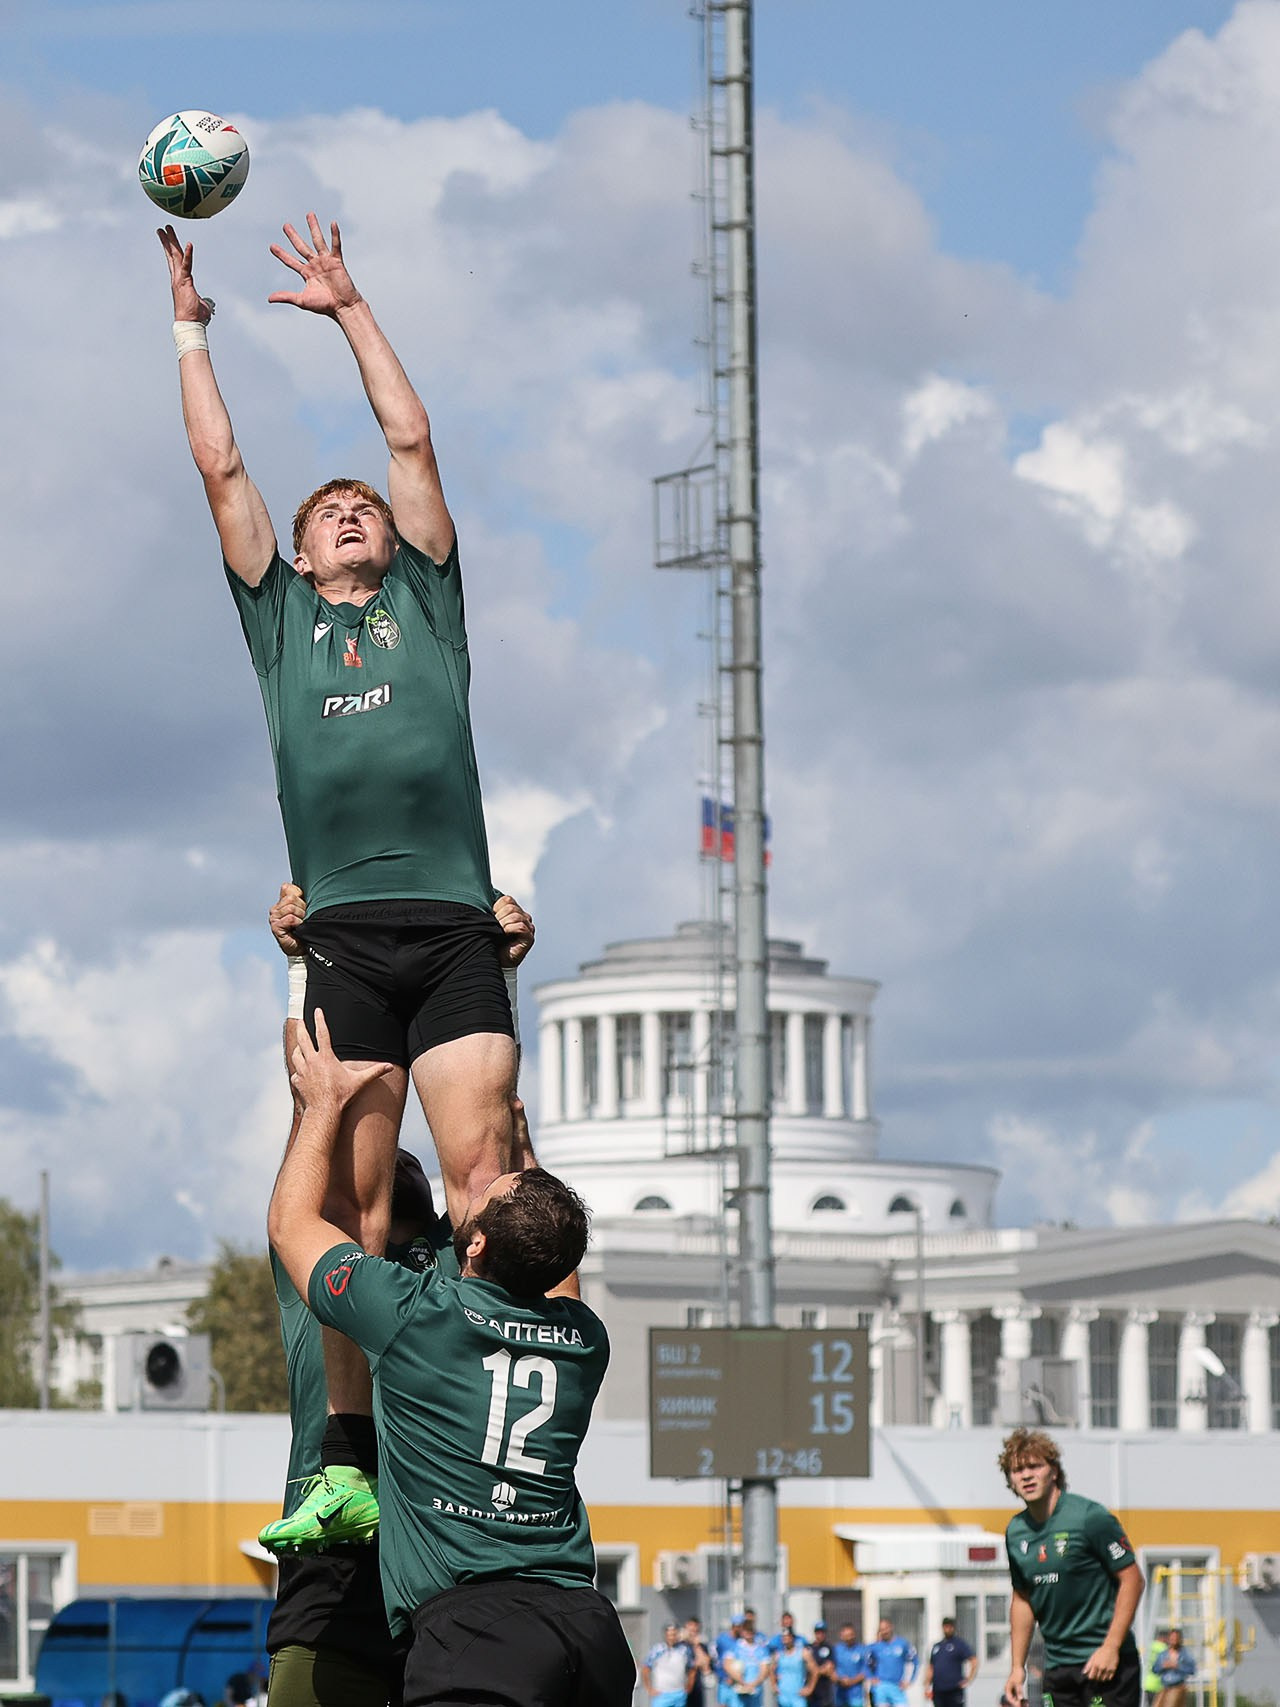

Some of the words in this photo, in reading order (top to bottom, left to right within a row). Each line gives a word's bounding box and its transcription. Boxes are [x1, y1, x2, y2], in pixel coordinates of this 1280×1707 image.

[323, 684, 391, 717] PARI
[488, 1319, 584, 1347] АПТЕКА
[690, 1344, 701, 1364] 2
[809, 1340, 854, 1383] 12
[480, 1348, 557, 1475] 12
[809, 1391, 854, 1434] 15
[697, 1448, 714, 1476] 2
[756, 1448, 822, 1476] 12:46
